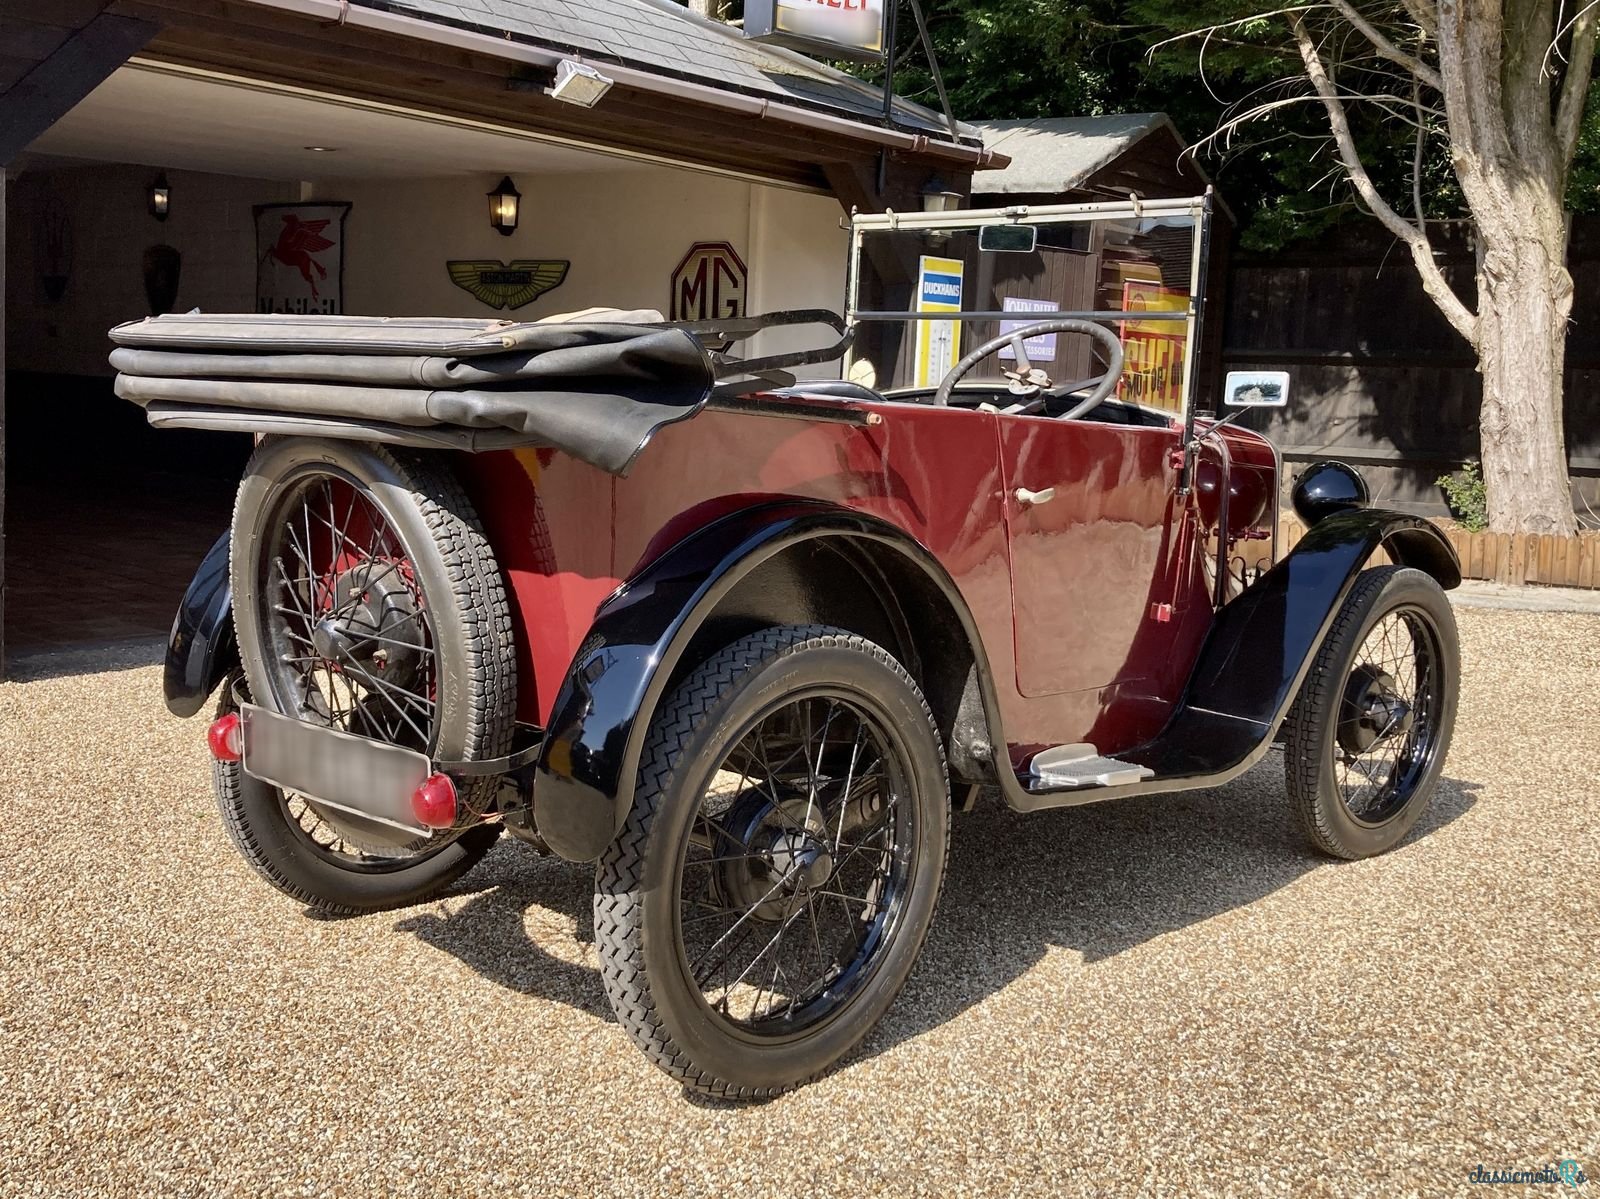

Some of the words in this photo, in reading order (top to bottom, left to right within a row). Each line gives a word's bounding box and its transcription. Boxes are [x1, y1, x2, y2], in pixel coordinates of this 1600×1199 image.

[681, 257, 738, 319] MG
[924, 281, 960, 297] DUCKHAMS
[1126, 365, 1164, 400] MOTOR
